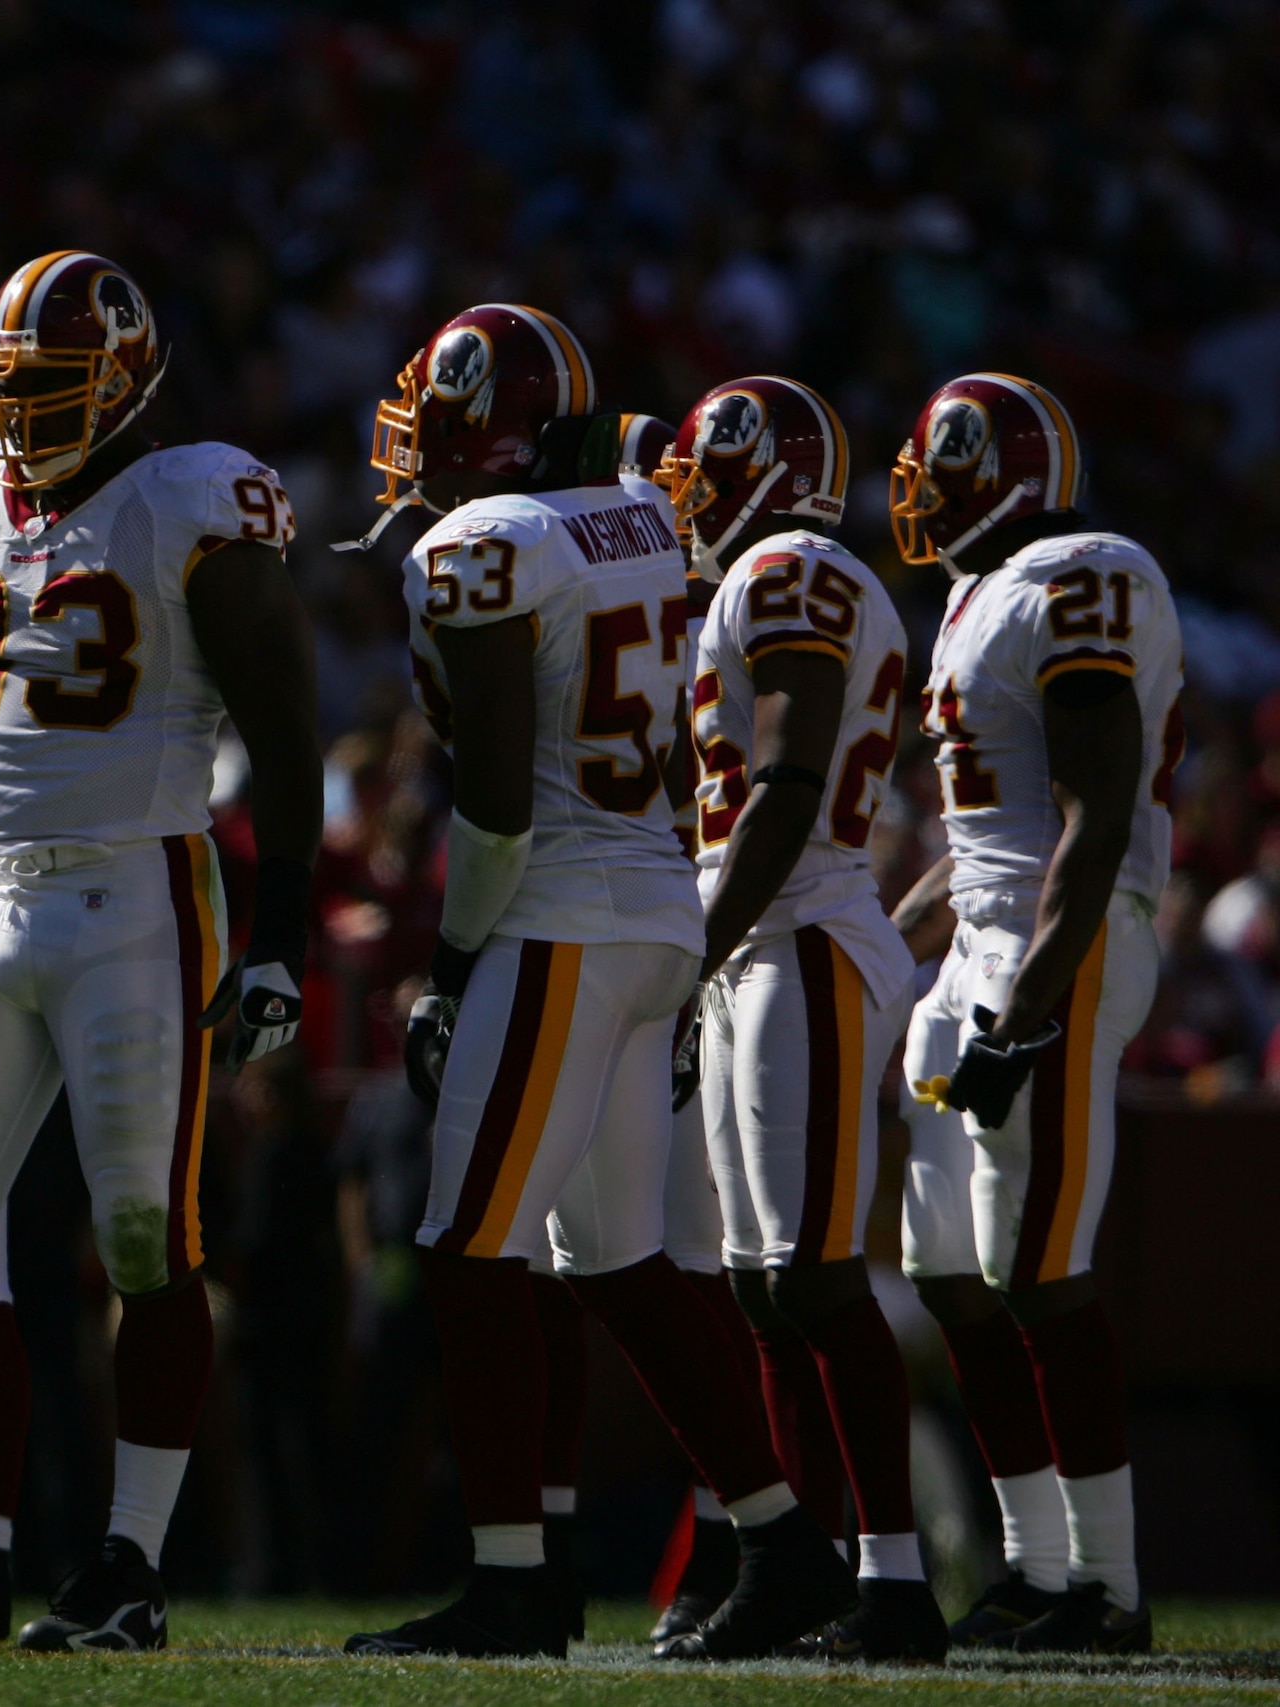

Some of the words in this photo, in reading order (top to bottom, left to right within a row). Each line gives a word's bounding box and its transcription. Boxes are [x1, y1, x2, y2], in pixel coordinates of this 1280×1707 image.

[561, 503, 679, 565] WASHINGTON
[426, 538, 515, 618] 53
[749, 553, 862, 640] 25
[1046, 566, 1134, 641] 21
